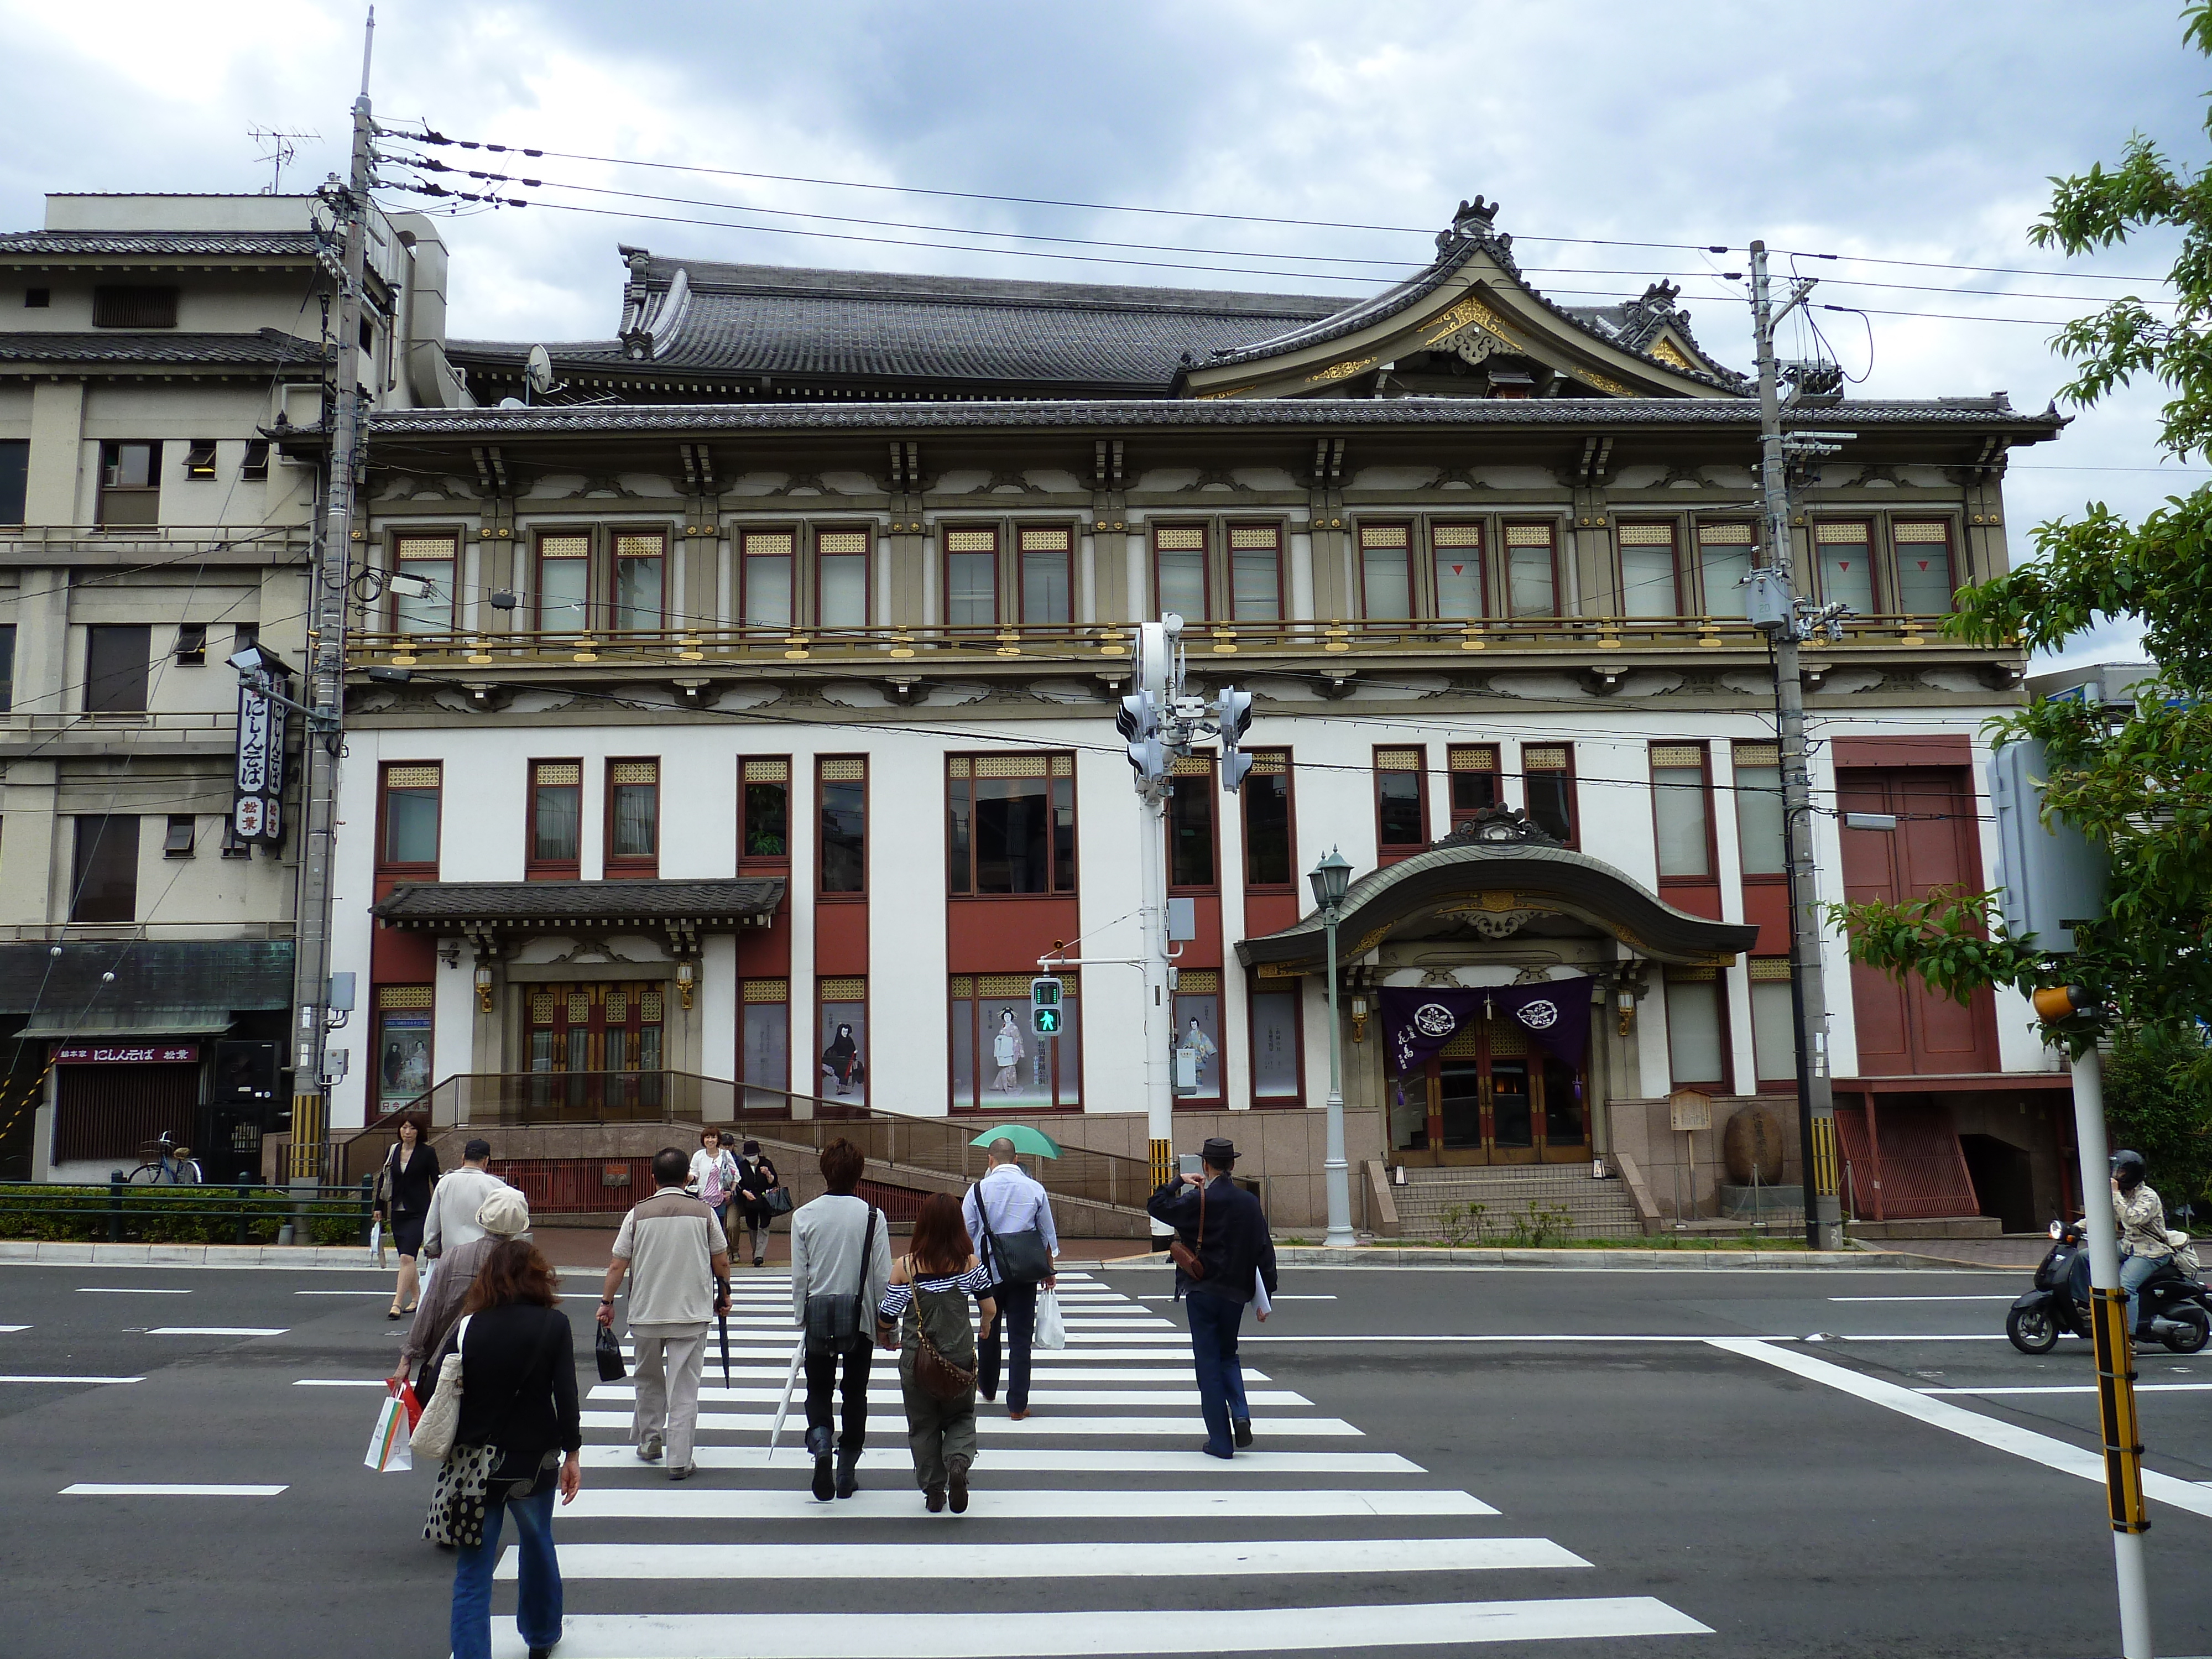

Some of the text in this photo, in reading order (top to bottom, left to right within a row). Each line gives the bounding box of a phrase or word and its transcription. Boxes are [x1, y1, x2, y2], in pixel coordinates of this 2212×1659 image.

[242, 700, 265, 785] にしんそば
[242, 801, 259, 830] 松葉
[94, 1048, 155, 1061] にしんそば
[163, 1050, 189, 1060] 松葉
